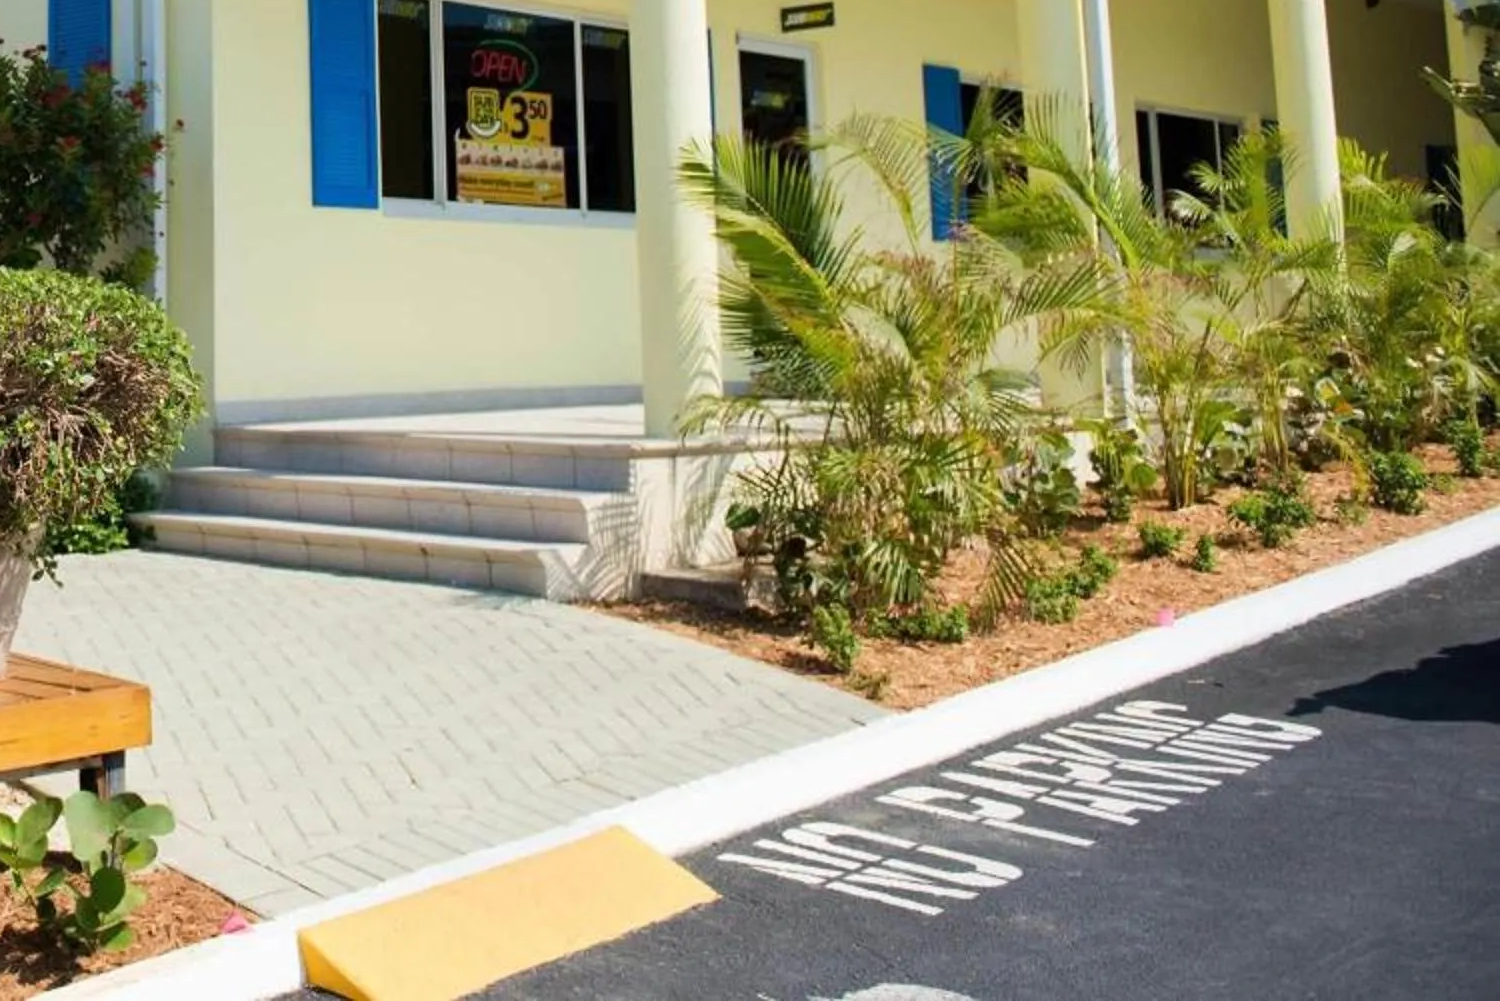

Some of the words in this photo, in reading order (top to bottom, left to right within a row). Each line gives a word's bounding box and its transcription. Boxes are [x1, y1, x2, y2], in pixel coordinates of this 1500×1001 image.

[471, 50, 528, 84] OPEN
[716, 821, 1024, 916] NO
[874, 700, 1323, 847] PARKING
